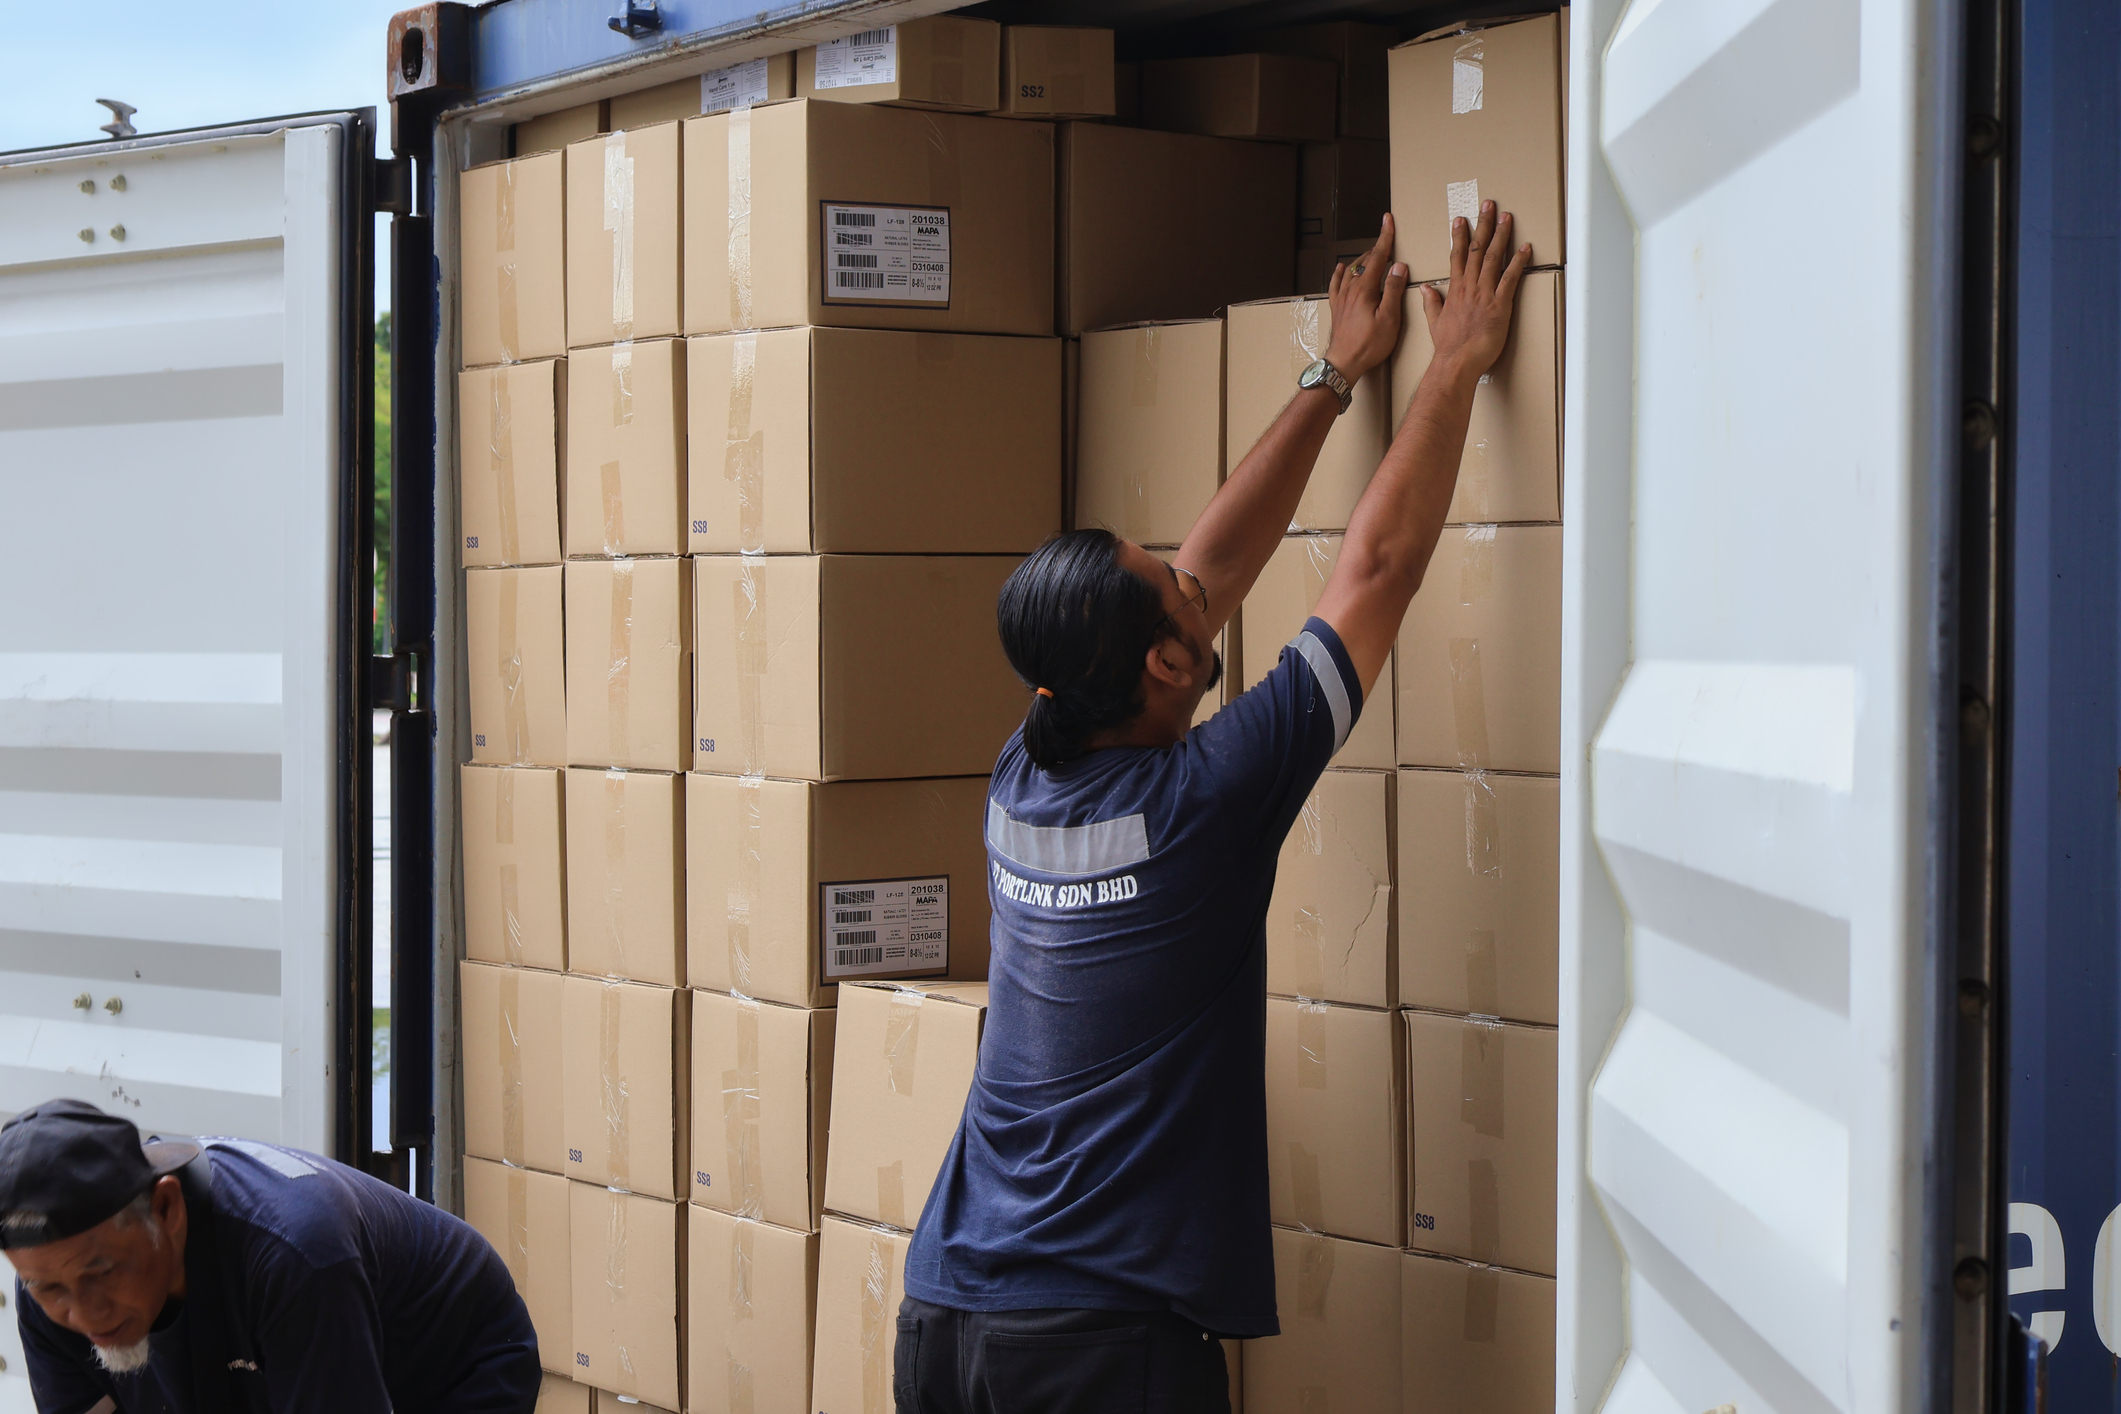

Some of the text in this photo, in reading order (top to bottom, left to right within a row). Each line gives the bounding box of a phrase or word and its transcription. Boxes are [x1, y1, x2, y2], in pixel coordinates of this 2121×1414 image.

[1021, 85, 1044, 98] SS2
[912, 215, 945, 225] 201038
[917, 226, 939, 235] MAPA
[912, 263, 944, 272] D310408
[692, 520, 708, 534] SS8
[466, 536, 479, 549] SS8
[475, 734, 486, 747] SS8
[699, 738, 715, 752] SS8
[911, 884, 944, 894] 201038
[998, 867, 1054, 907] PORTLINK
[1056, 882, 1093, 908] SDN
[1096, 875, 1138, 904] BHD
[916, 896, 938, 905] MAPA
[910, 931, 942, 941] D310408
[568, 1148, 583, 1163] SS8
[696, 1170, 711, 1187] SS8
[1415, 1212, 1435, 1230] SS8
[576, 1351, 590, 1367] SS8
